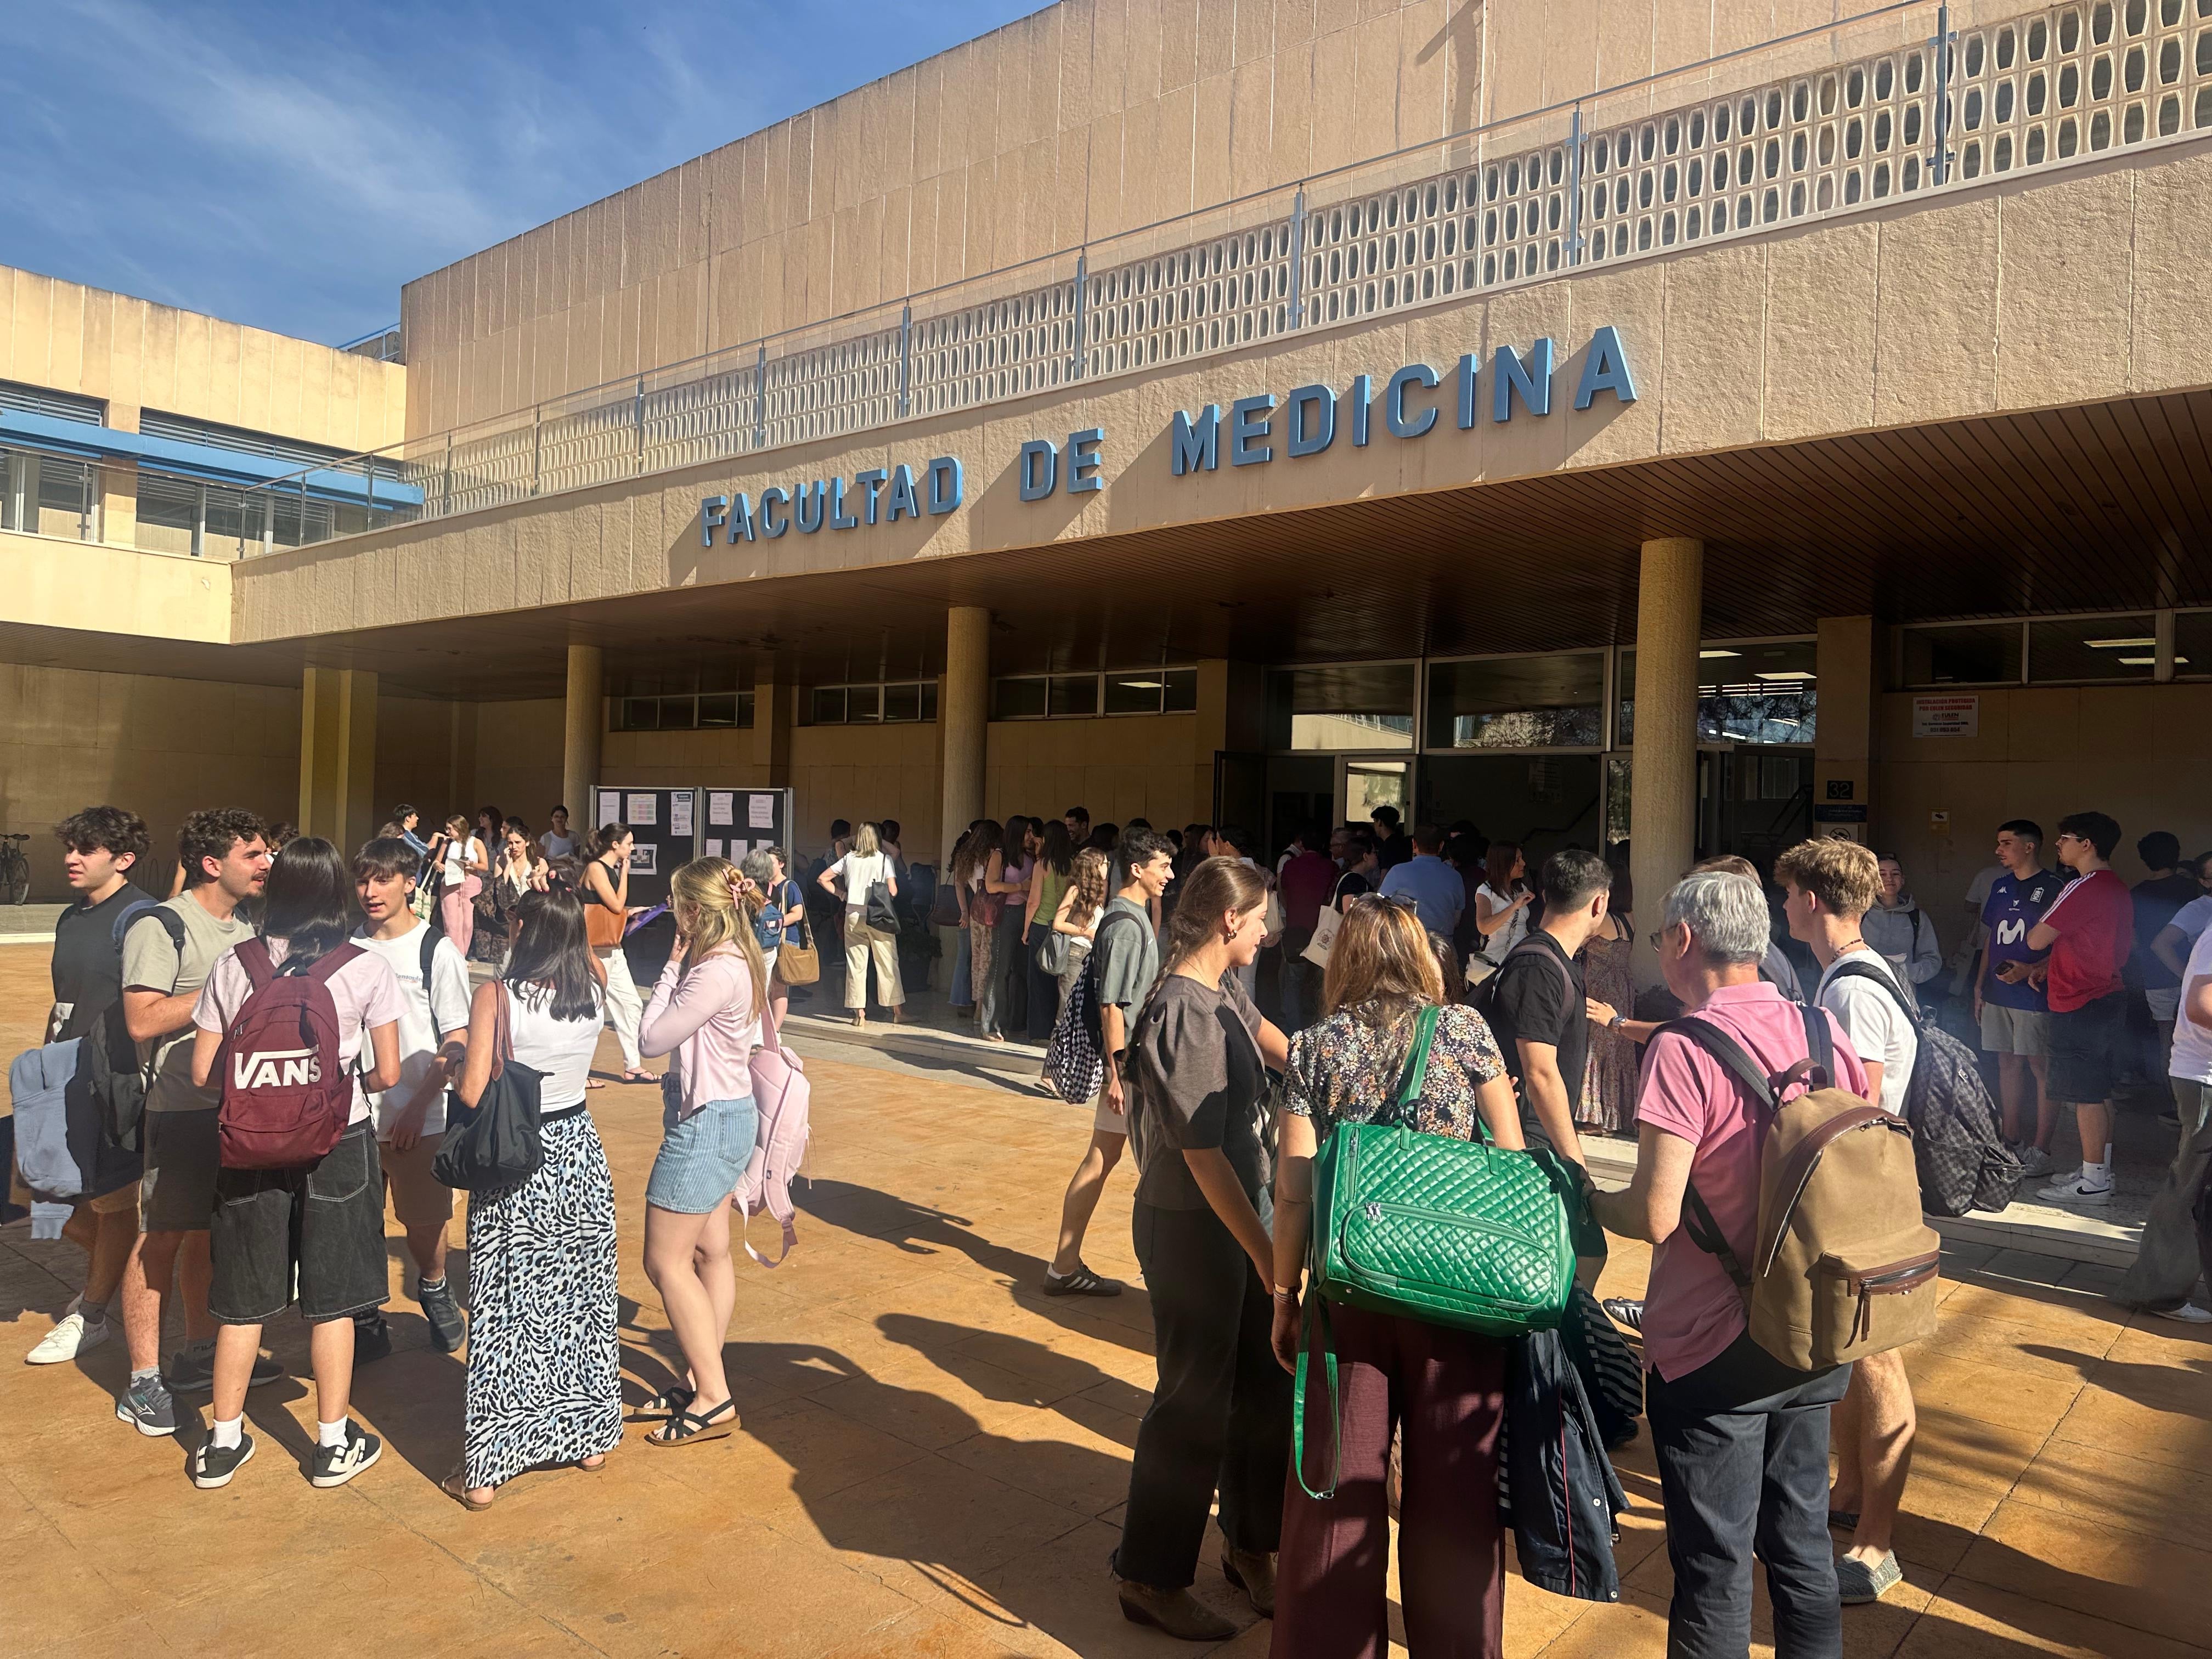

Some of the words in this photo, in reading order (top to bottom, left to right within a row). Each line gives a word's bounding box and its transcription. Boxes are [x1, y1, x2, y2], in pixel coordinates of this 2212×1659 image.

[700, 455, 963, 548] FACULTAD
[1019, 427, 1104, 502] DE
[1171, 325, 1639, 477] MEDICINA
[1830, 782, 1850, 798] 32
[234, 1043, 321, 1090] VANS
